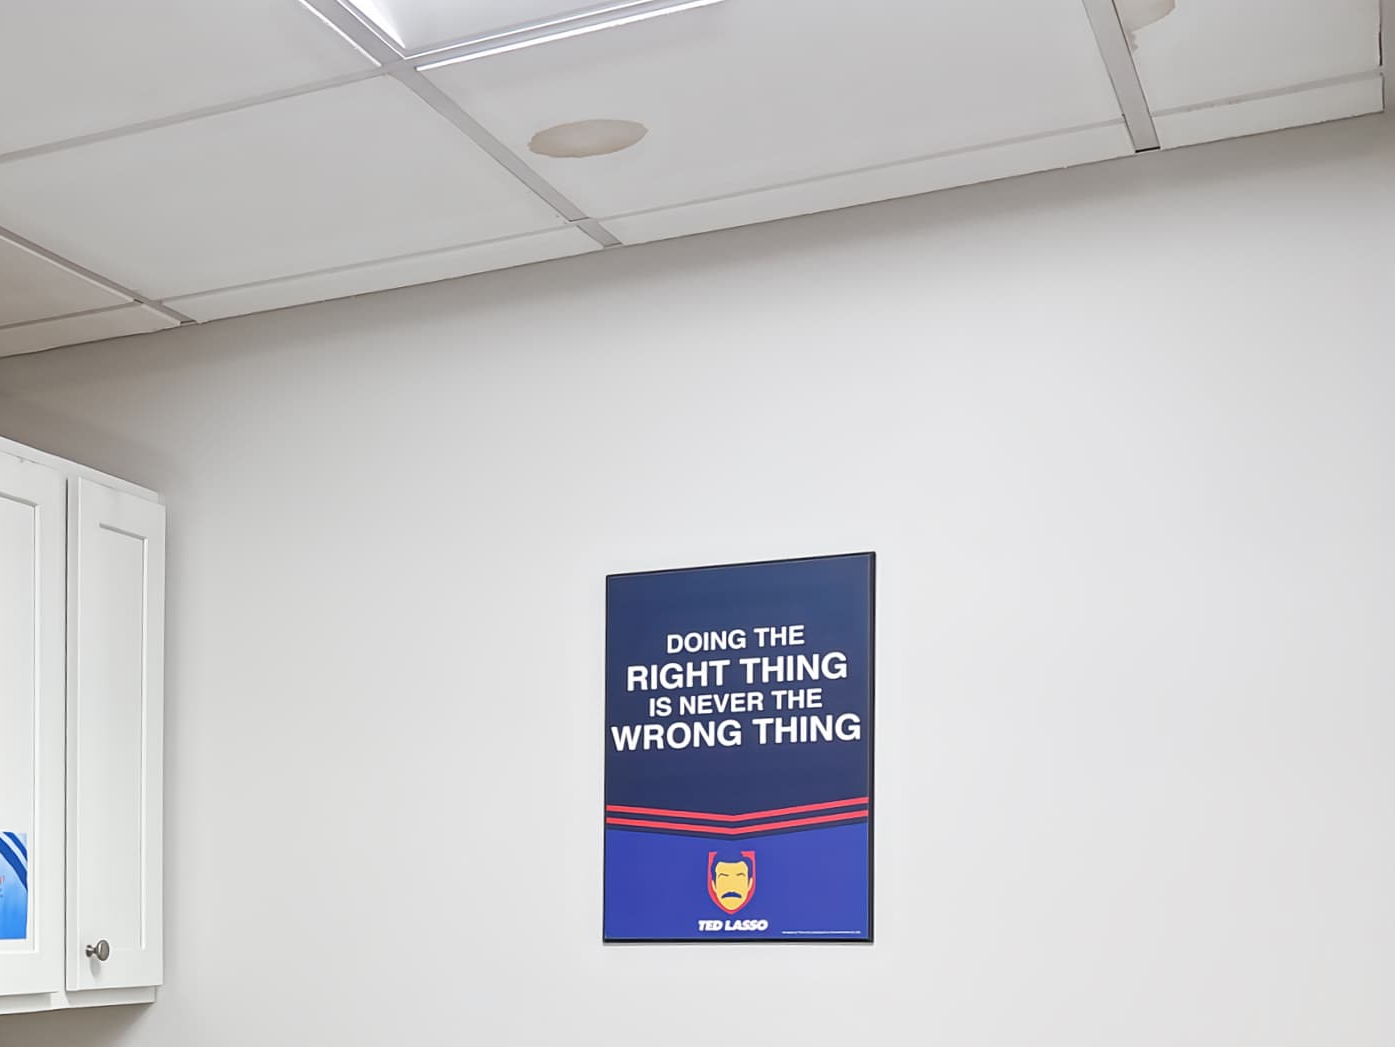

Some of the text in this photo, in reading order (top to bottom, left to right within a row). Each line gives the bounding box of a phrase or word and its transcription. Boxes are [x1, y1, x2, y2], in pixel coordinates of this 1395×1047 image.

[667, 624, 805, 653] DOING THE
[627, 651, 848, 692] RIGHT THING
[649, 687, 823, 718] IS NEVER THE
[610, 712, 861, 752] WRONG THING
[698, 919, 769, 932] TED LASSO
